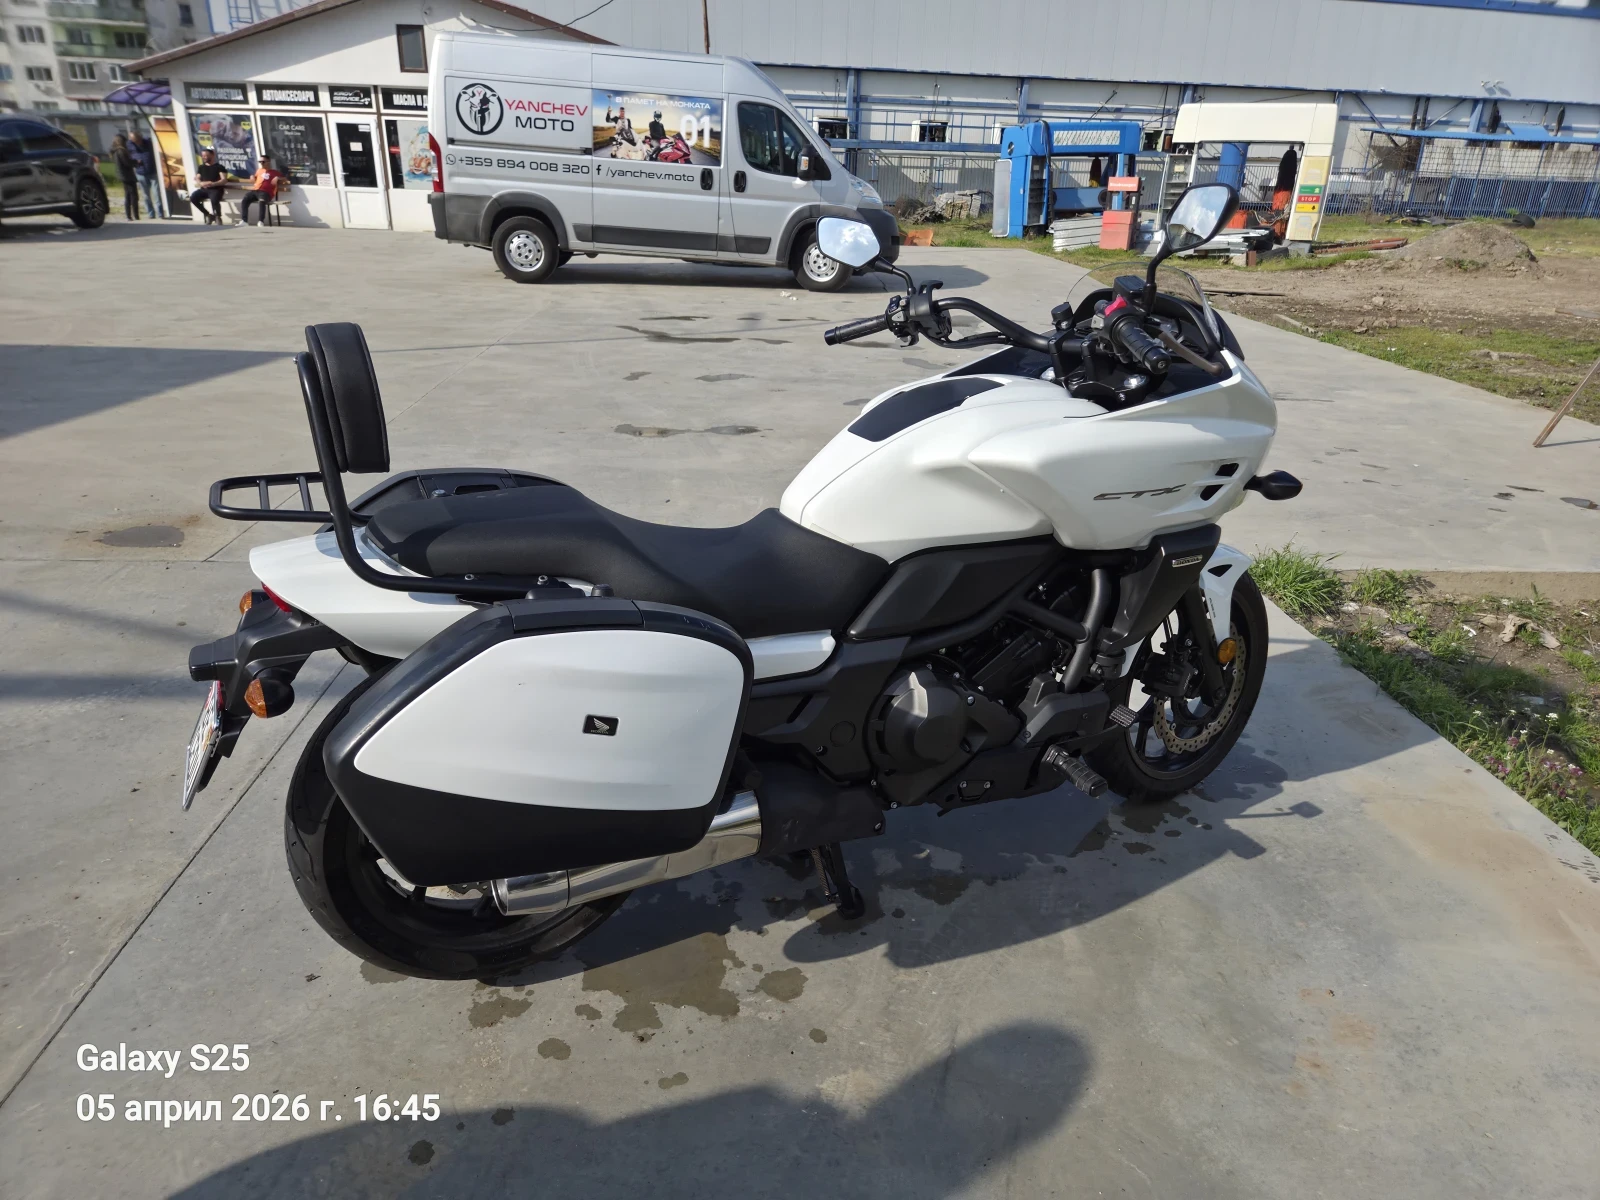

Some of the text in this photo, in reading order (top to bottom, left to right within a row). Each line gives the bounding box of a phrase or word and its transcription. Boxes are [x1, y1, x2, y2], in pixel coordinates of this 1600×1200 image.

[393, 94, 416, 106] МАСЛА
[505, 99, 588, 116] YANCHEV
[671, 101, 711, 109] МОНКАТА
[516, 116, 574, 132] MOTO
[680, 114, 710, 149] 01
[458, 156, 590, 174] +359 894 008 320
[606, 167, 695, 182] /yanchev.moto
[1093, 484, 1186, 500] CTX
